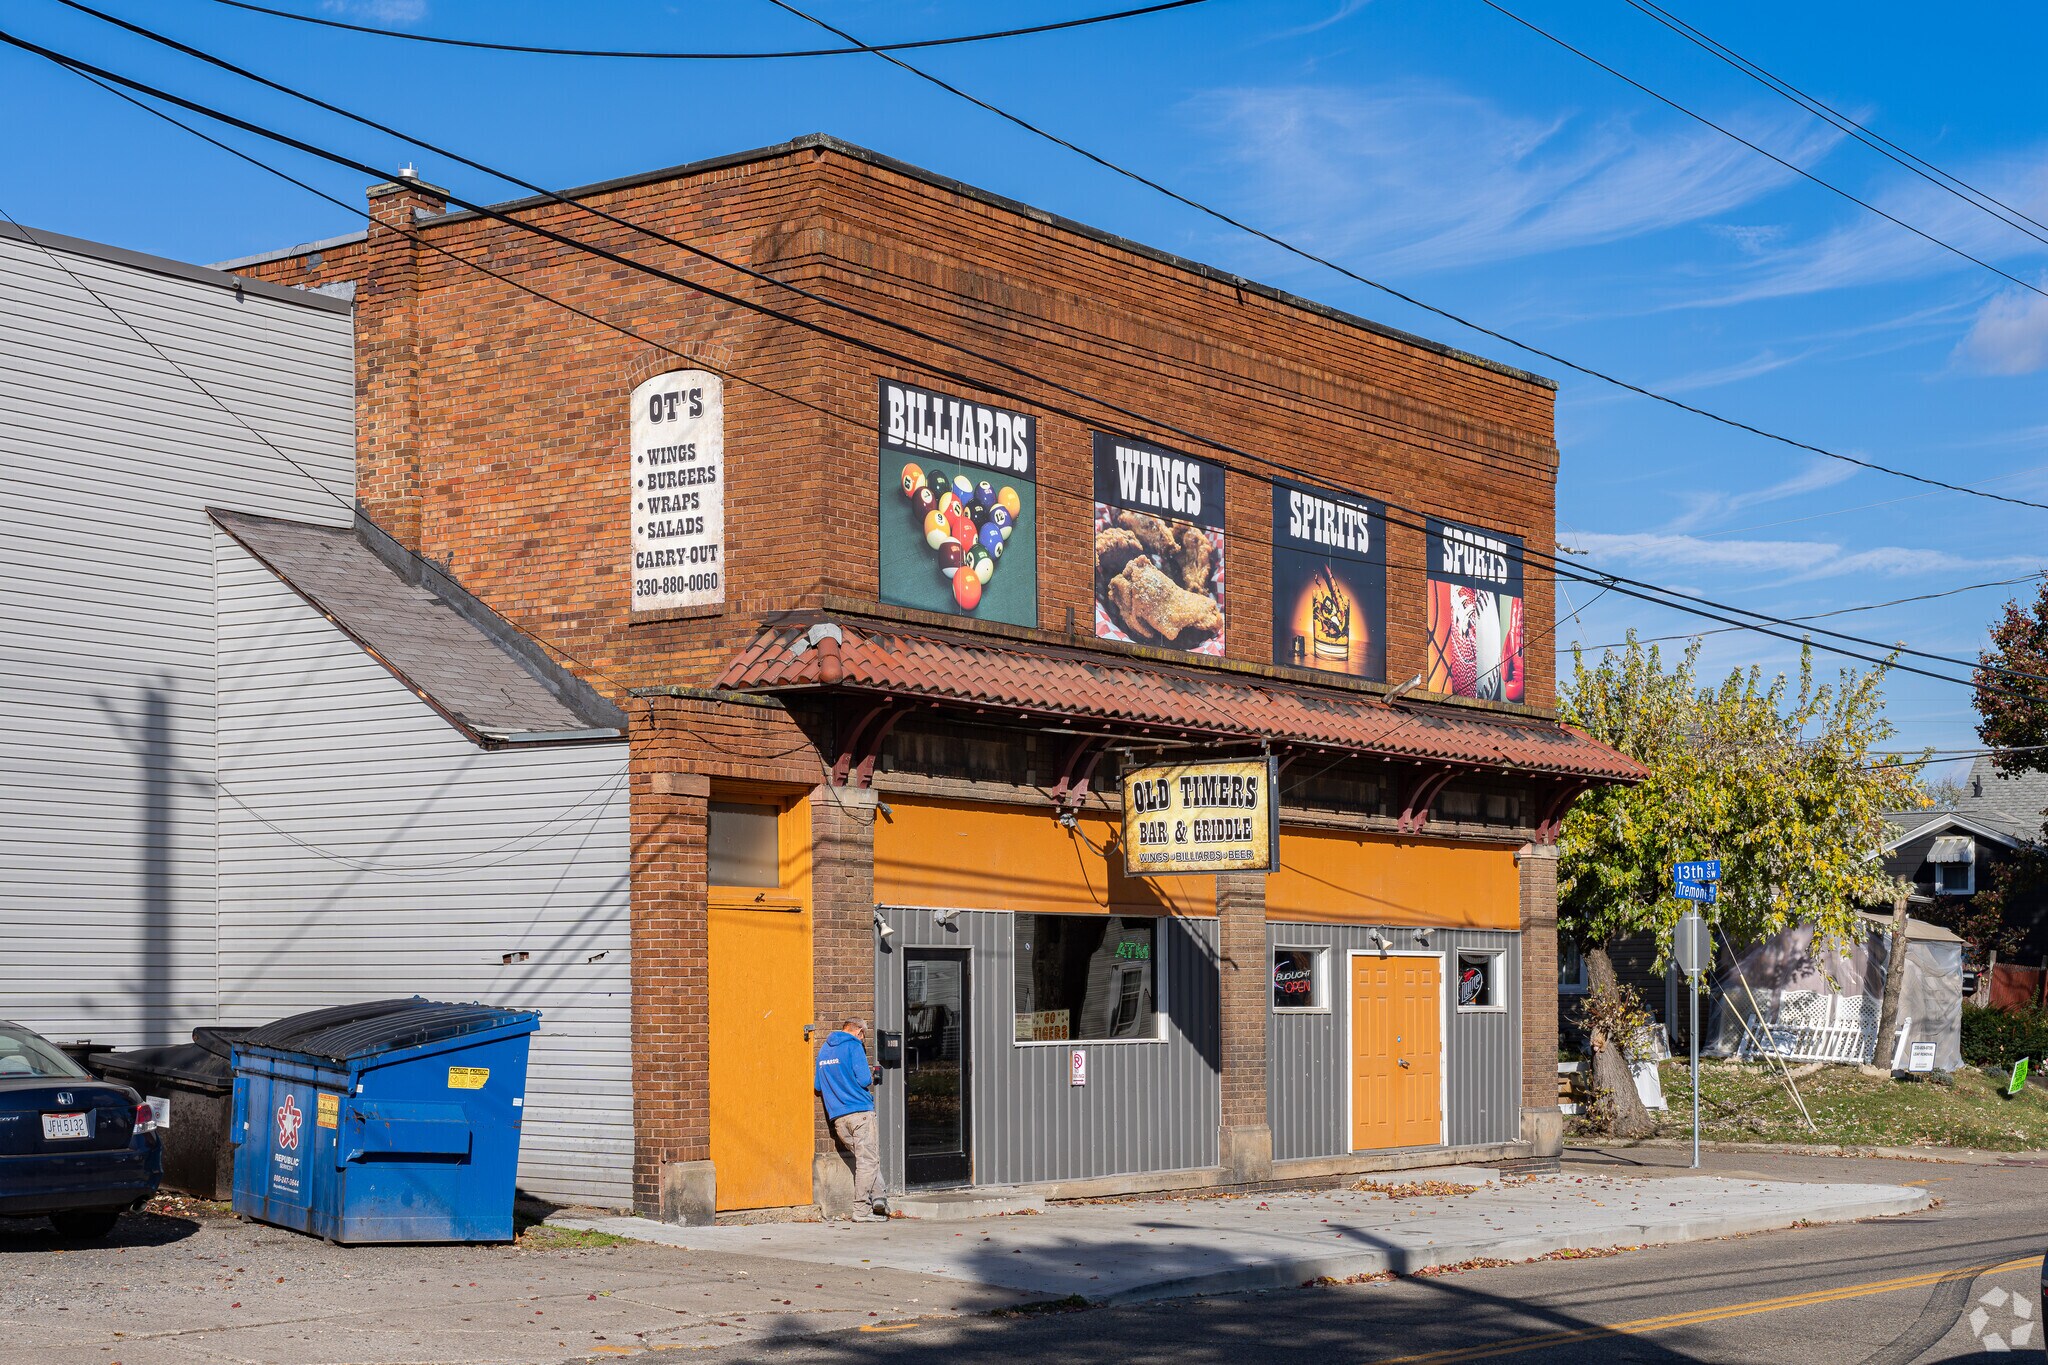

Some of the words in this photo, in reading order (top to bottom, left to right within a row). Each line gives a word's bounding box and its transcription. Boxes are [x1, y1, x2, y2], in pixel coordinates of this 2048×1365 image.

[649, 387, 704, 424] OT'S
[887, 385, 1028, 473] BILLIARDS
[647, 443, 696, 466] WINGS
[647, 465, 716, 490] BURGERS
[1115, 445, 1201, 516] WINGS
[647, 492, 700, 514] WRAPS
[647, 516, 704, 539] SALADS
[1289, 490, 1369, 554] SPIRITS
[636, 544, 718, 569] CARRY-OUT
[1442, 526, 1508, 585] SPORTS
[636, 572, 718, 597] 330-880-0060
[1133, 777, 1171, 814] OLD
[1179, 774, 1258, 810] TIMERS
[1139, 820, 1169, 845] BAR
[1174, 819, 1188, 844] &
[1193, 816, 1254, 844] GRIDDLE
[1139, 853, 1170, 863] WINGS
[1175, 850, 1222, 862] BILLIARDS
[1228, 849, 1254, 860] BEER
[1677, 864, 1704, 880] 13th
[1707, 862, 1716, 870] ST
[1706, 870, 1717, 879] SW
[1678, 881, 1707, 900] Tremont
[1115, 942, 1149, 959] ATM
[1285, 980, 1311, 993] OPEN
[1043, 1011, 1056, 1025] GO
[1033, 1024, 1068, 1041] TIGERS
[48, 1119, 63, 1133] JFH
[64, 1118, 85, 1133] 5132
[274, 1153, 300, 1167] REPUBLIC
